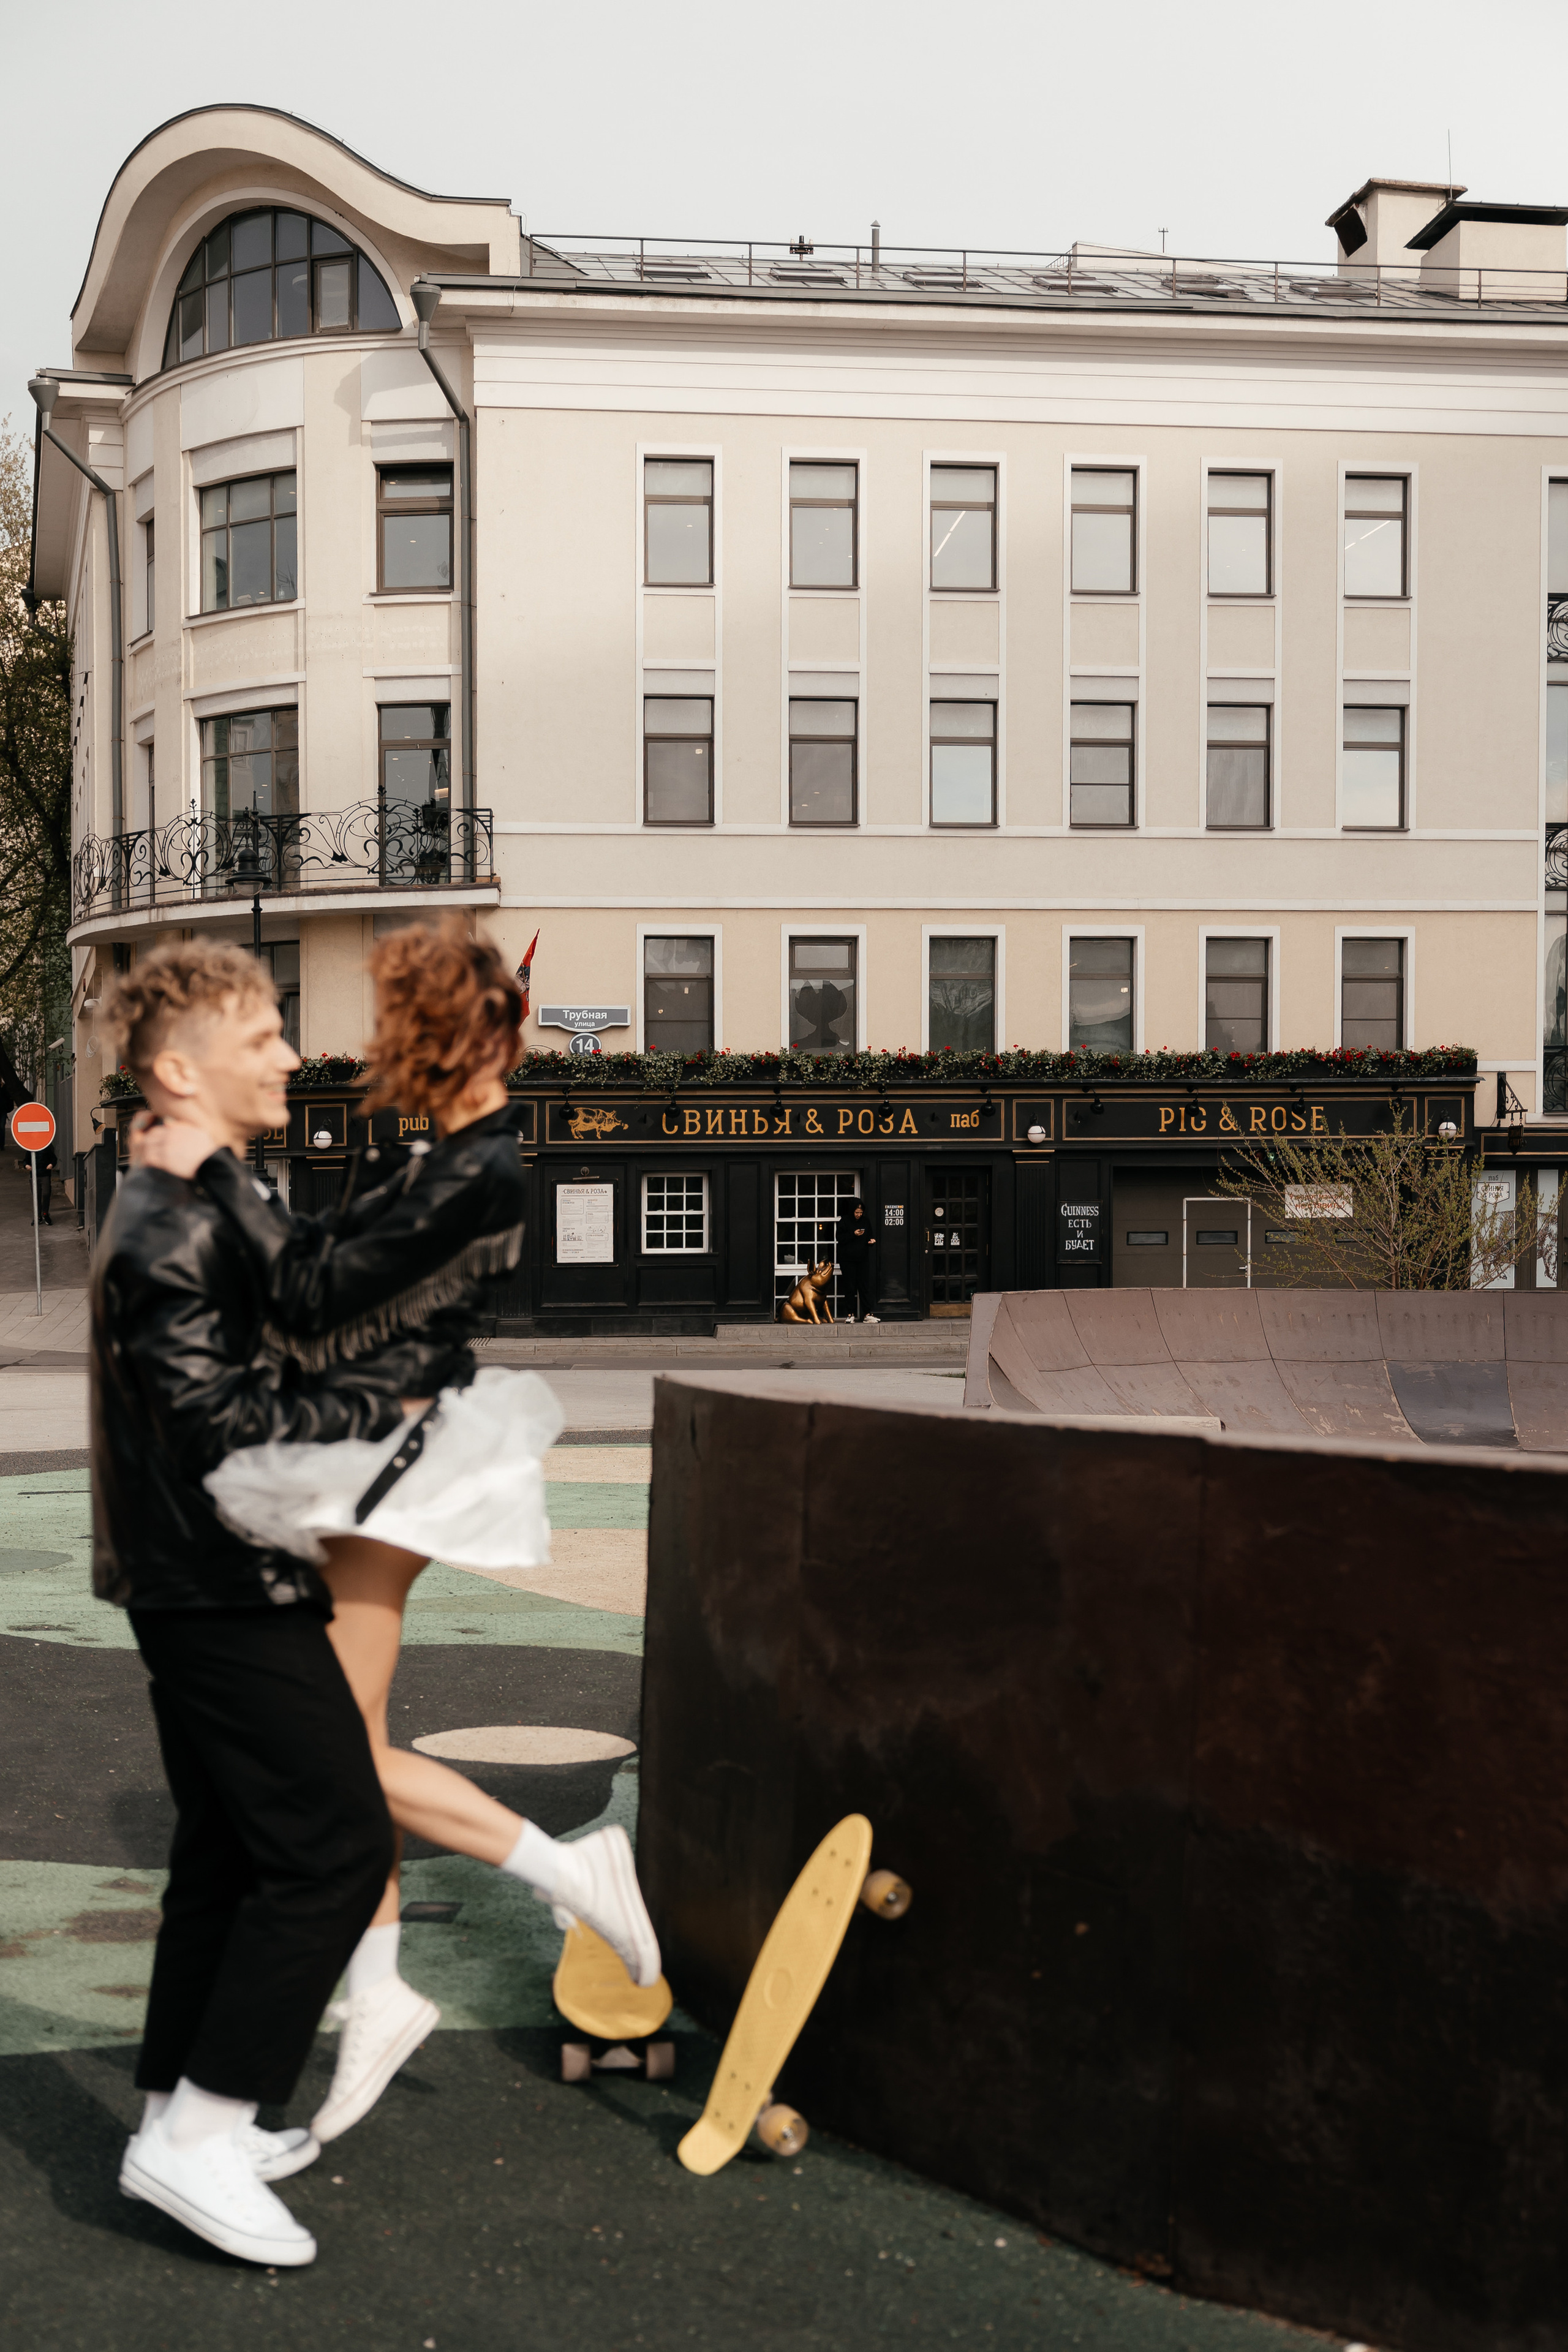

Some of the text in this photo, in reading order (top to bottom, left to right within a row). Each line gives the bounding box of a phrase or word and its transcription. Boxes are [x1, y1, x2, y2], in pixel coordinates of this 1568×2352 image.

[562, 1009, 608, 1021] Трубная
[576, 1038, 595, 1054] 14
[398, 1112, 429, 1137] pub
[662, 1108, 919, 1134] СВИНЬЯ & РОЗА
[950, 1109, 980, 1128] паб
[1159, 1106, 1324, 1132] PIG & ROSE
[1061, 1203, 1099, 1217] GUINNESS
[1068, 1219, 1092, 1229] ЕСТЬ
[1076, 1230, 1084, 1238] И
[1065, 1239, 1095, 1251] БУДЕТ
